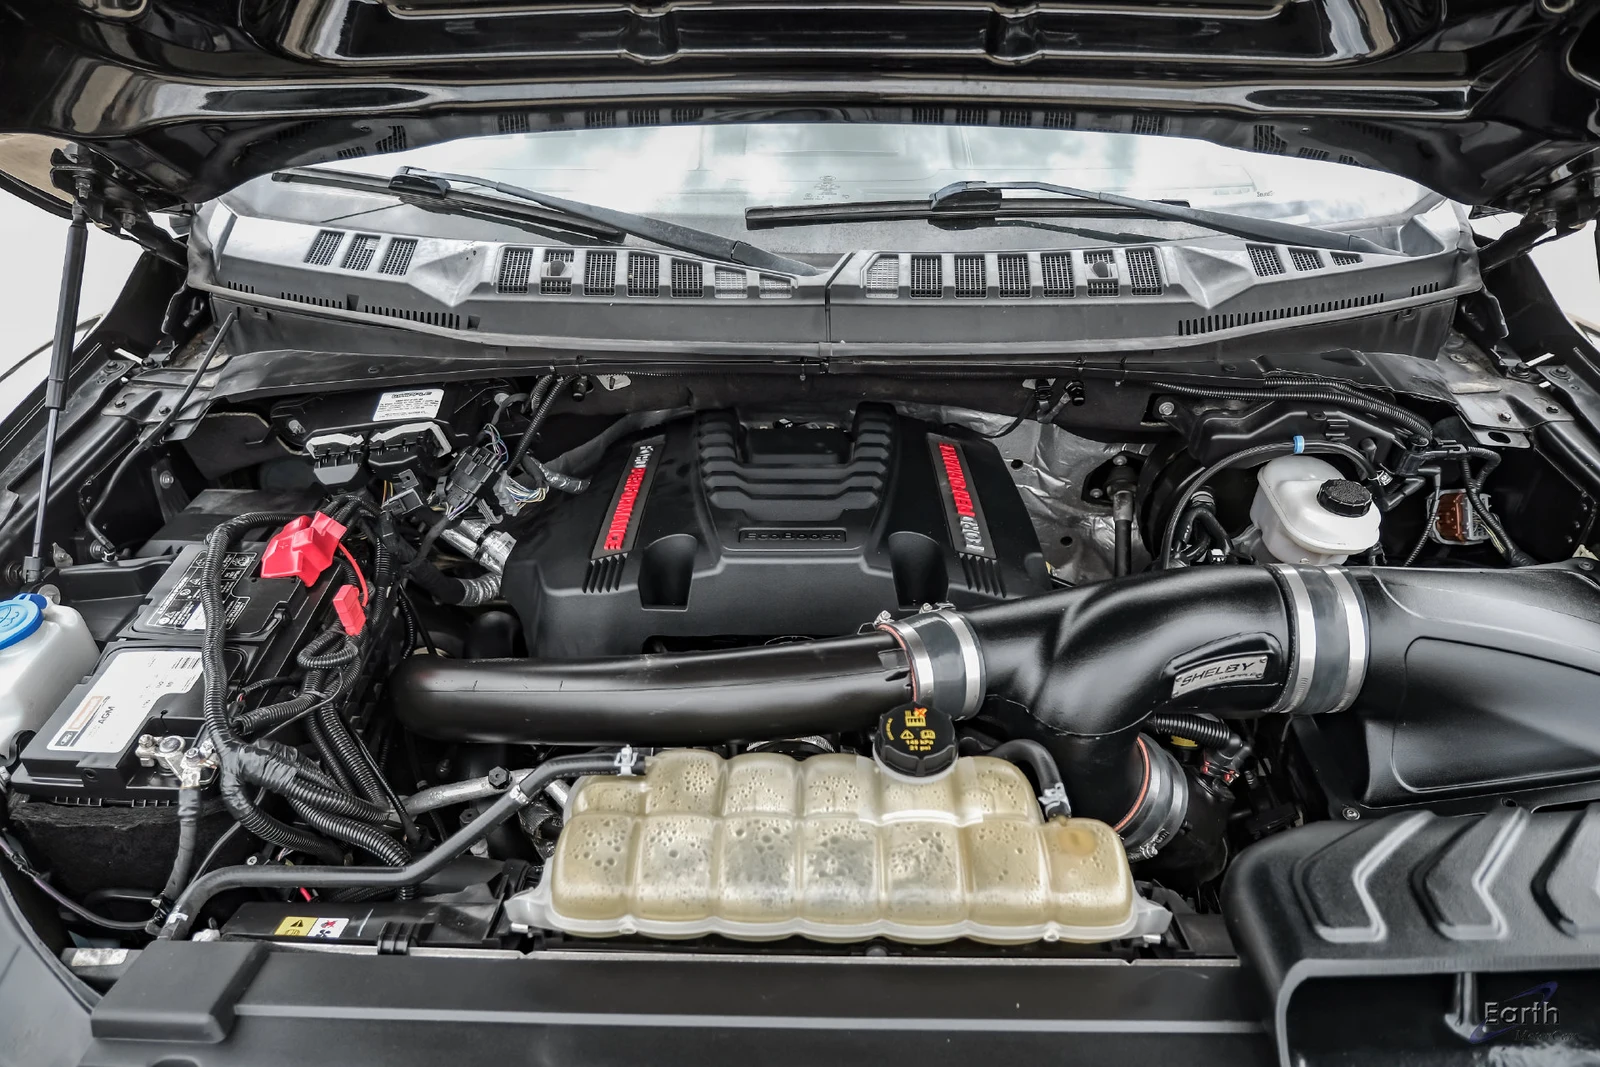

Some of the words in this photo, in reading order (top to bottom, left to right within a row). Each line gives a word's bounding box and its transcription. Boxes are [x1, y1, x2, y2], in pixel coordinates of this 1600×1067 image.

[939, 441, 976, 518] PERFORMANCE
[604, 467, 647, 551] PERFORMANCE
[959, 516, 985, 552] FORD
[1181, 662, 1254, 687] SHELBY
[98, 705, 116, 724] AGM
